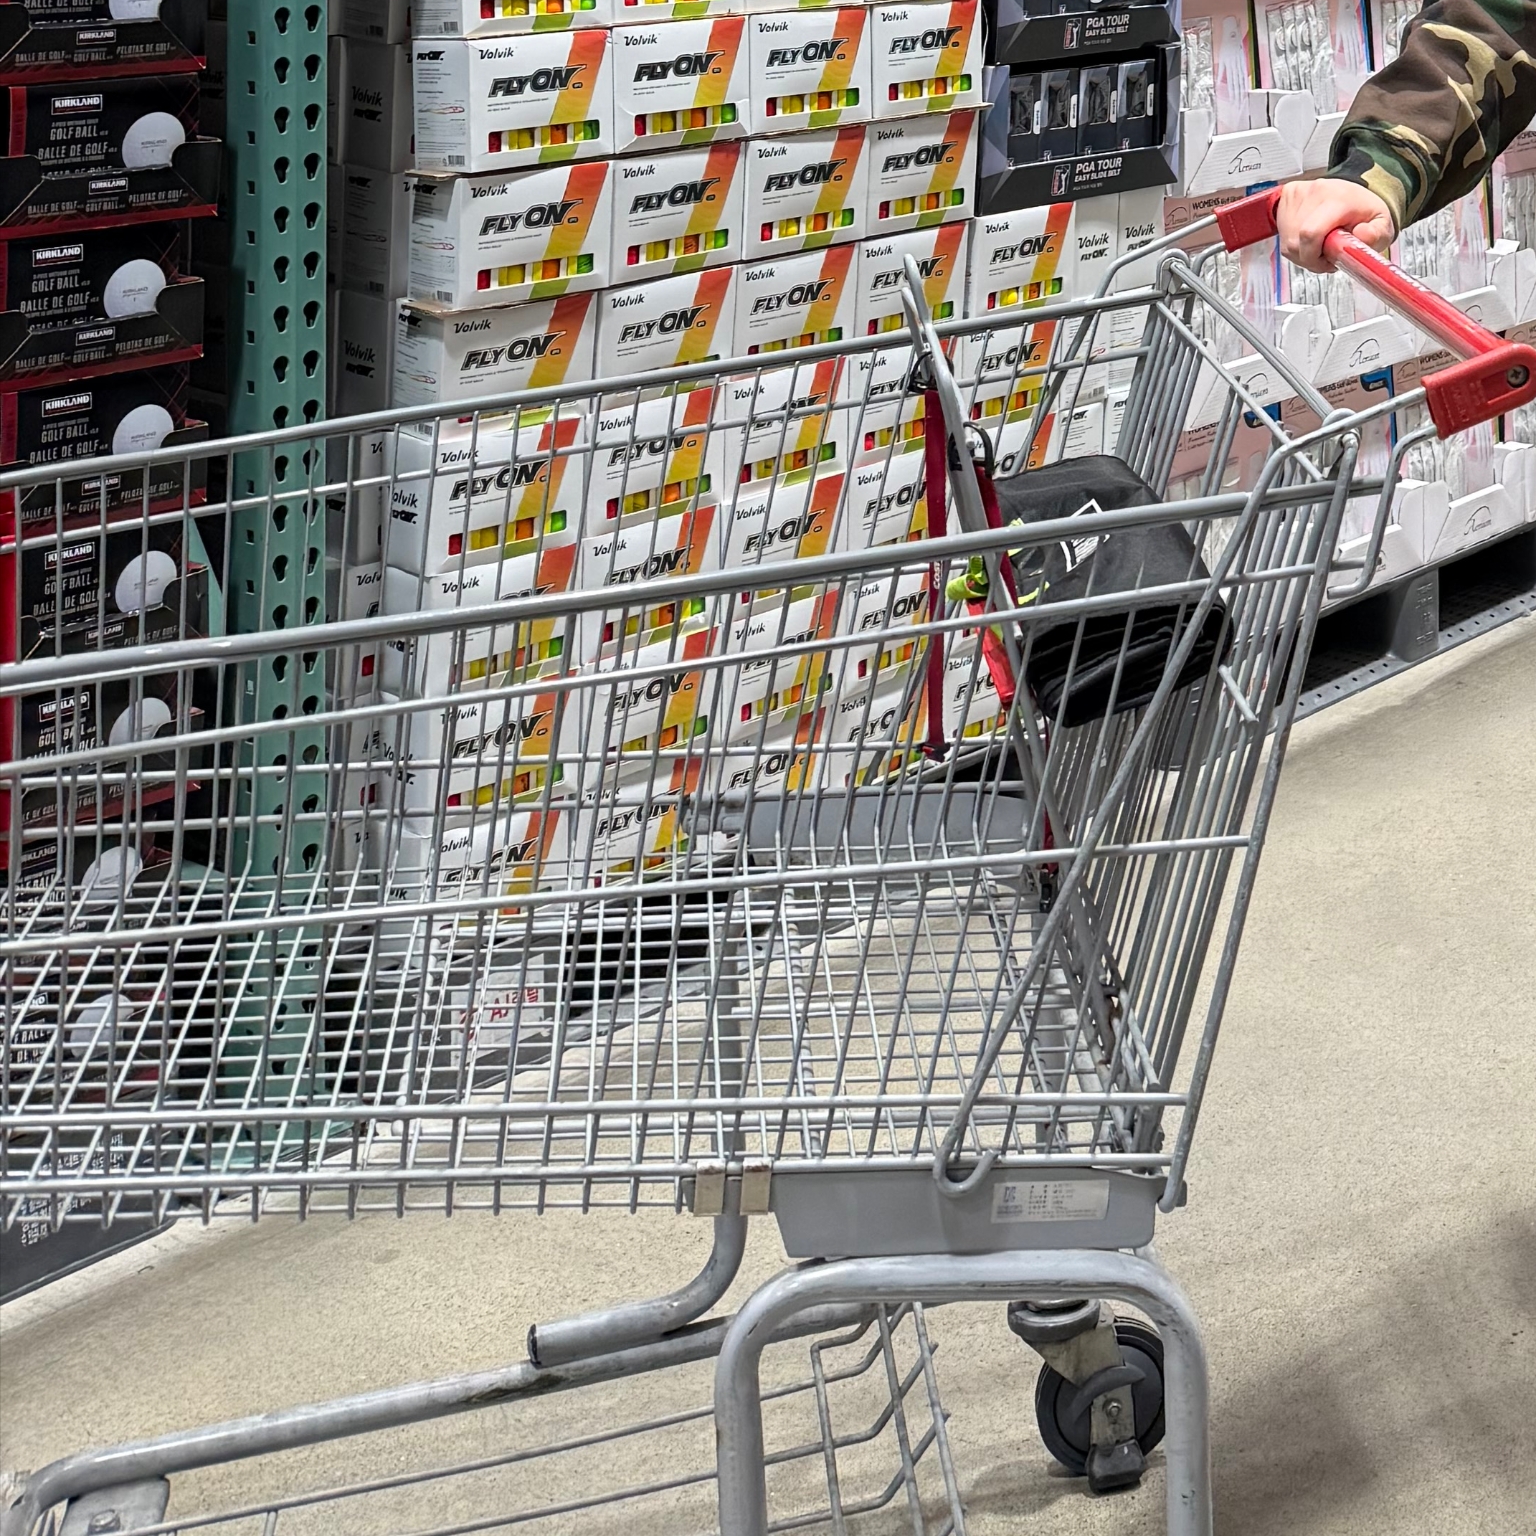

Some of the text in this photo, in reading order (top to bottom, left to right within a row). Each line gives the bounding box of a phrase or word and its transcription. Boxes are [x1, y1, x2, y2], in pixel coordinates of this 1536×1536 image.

[758, 22, 789, 33] Volvik
[1086, 14, 1129, 29] PGA TOUR
[79, 31, 114, 39] KIRKLAND
[1085, 28, 1100, 37] EASY
[624, 34, 658, 46] Volvik
[479, 47, 515, 61] Volvik
[55, 97, 100, 109] KIRKLAND
[50, 126, 98, 140] GOLF BALL
[38, 142, 108, 160] BALLE DE GOLF
[1076, 157, 1122, 173] PGA TOUR
[622, 165, 656, 180] Volvik
[1074, 173, 1091, 183] EASY
[91, 180, 126, 189] KIRKLAND
[471, 184, 509, 199] Volvik
[36, 247, 80, 260] KIRKLAND
[32, 276, 80, 293] GOLF BALL
[52, 296, 64, 307] DE
[67, 292, 90, 306] GOLF
[454, 319, 492, 334] Volvik
[79, 329, 113, 340] KIRKLAND
